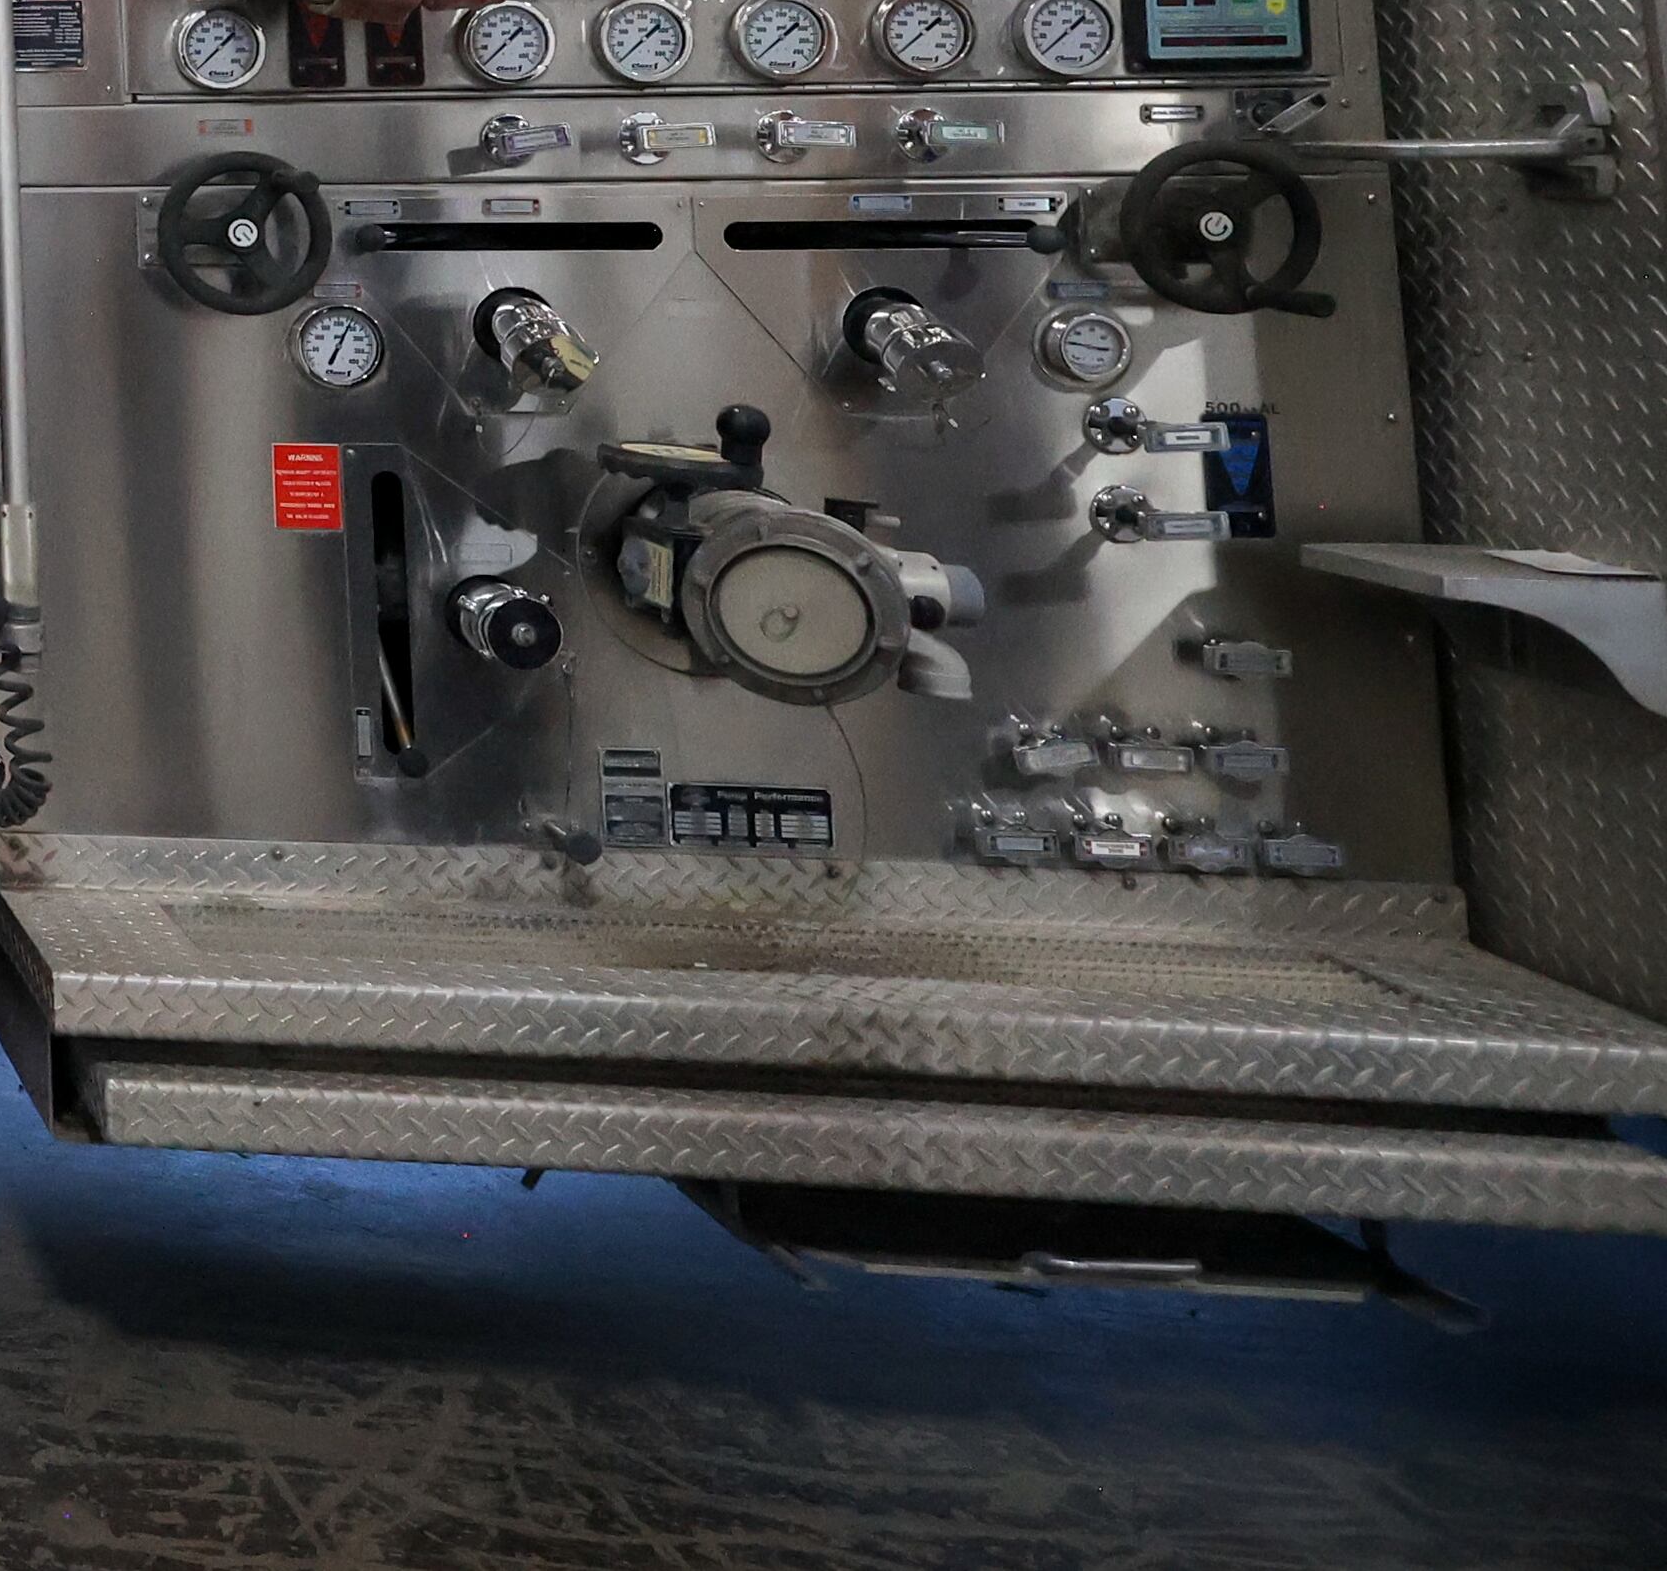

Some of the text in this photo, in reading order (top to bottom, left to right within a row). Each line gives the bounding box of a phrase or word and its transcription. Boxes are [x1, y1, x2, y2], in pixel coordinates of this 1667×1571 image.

[1205, 401, 1241, 415] 500
[287, 453, 324, 462] WARNING
[753, 791, 824, 802] Performance
